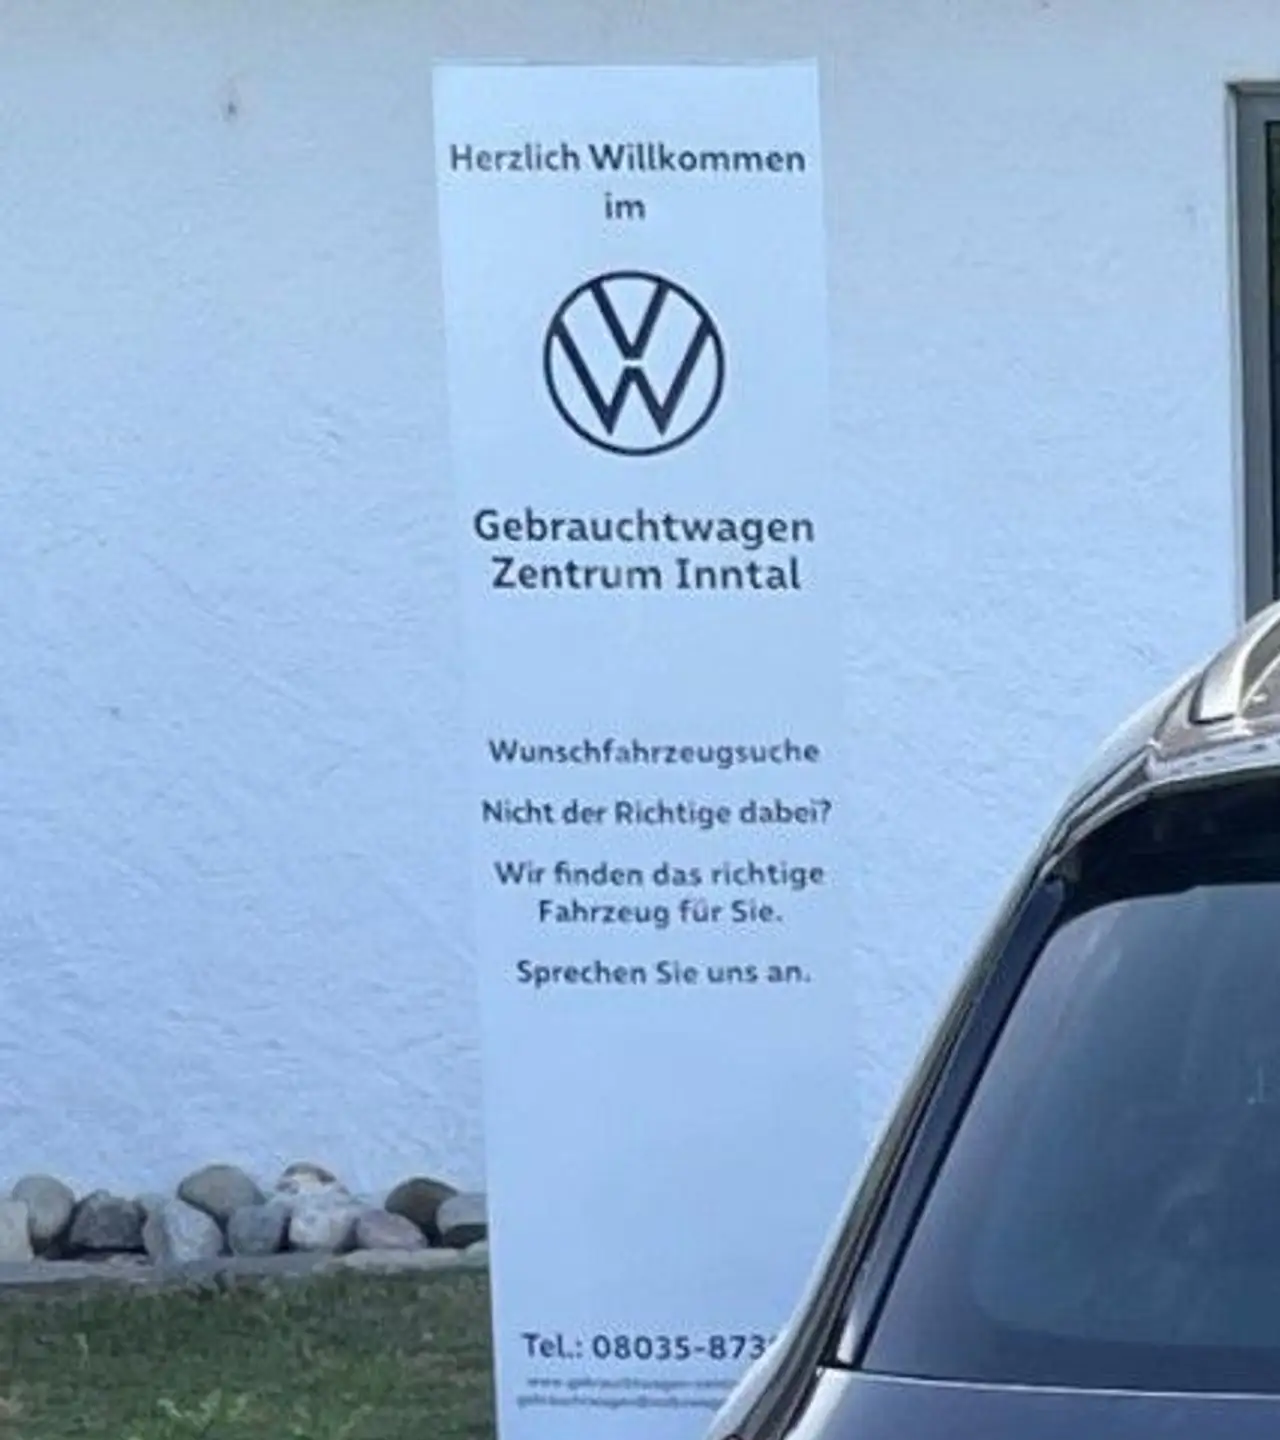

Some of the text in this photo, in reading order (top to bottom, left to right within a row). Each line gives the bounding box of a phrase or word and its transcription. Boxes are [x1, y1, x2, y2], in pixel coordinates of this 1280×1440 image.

[450, 142, 805, 172] Herzlich Willkommen
[605, 192, 645, 219] im
[474, 507, 814, 551] Gebrauchtwagen
[492, 556, 801, 590] Zentrum Inntal
[489, 738, 820, 769] Wunschfahrzeugsuche
[482, 798, 832, 830] Nicht der Richtige dabei?
[494, 860, 824, 891] Wir finden das richtige
[539, 899, 782, 929] Fahrzeug für Sie.
[516, 960, 810, 989] Sprechen Sie uns an.
[521, 1332, 775, 1361] Tel.: 08035-873
